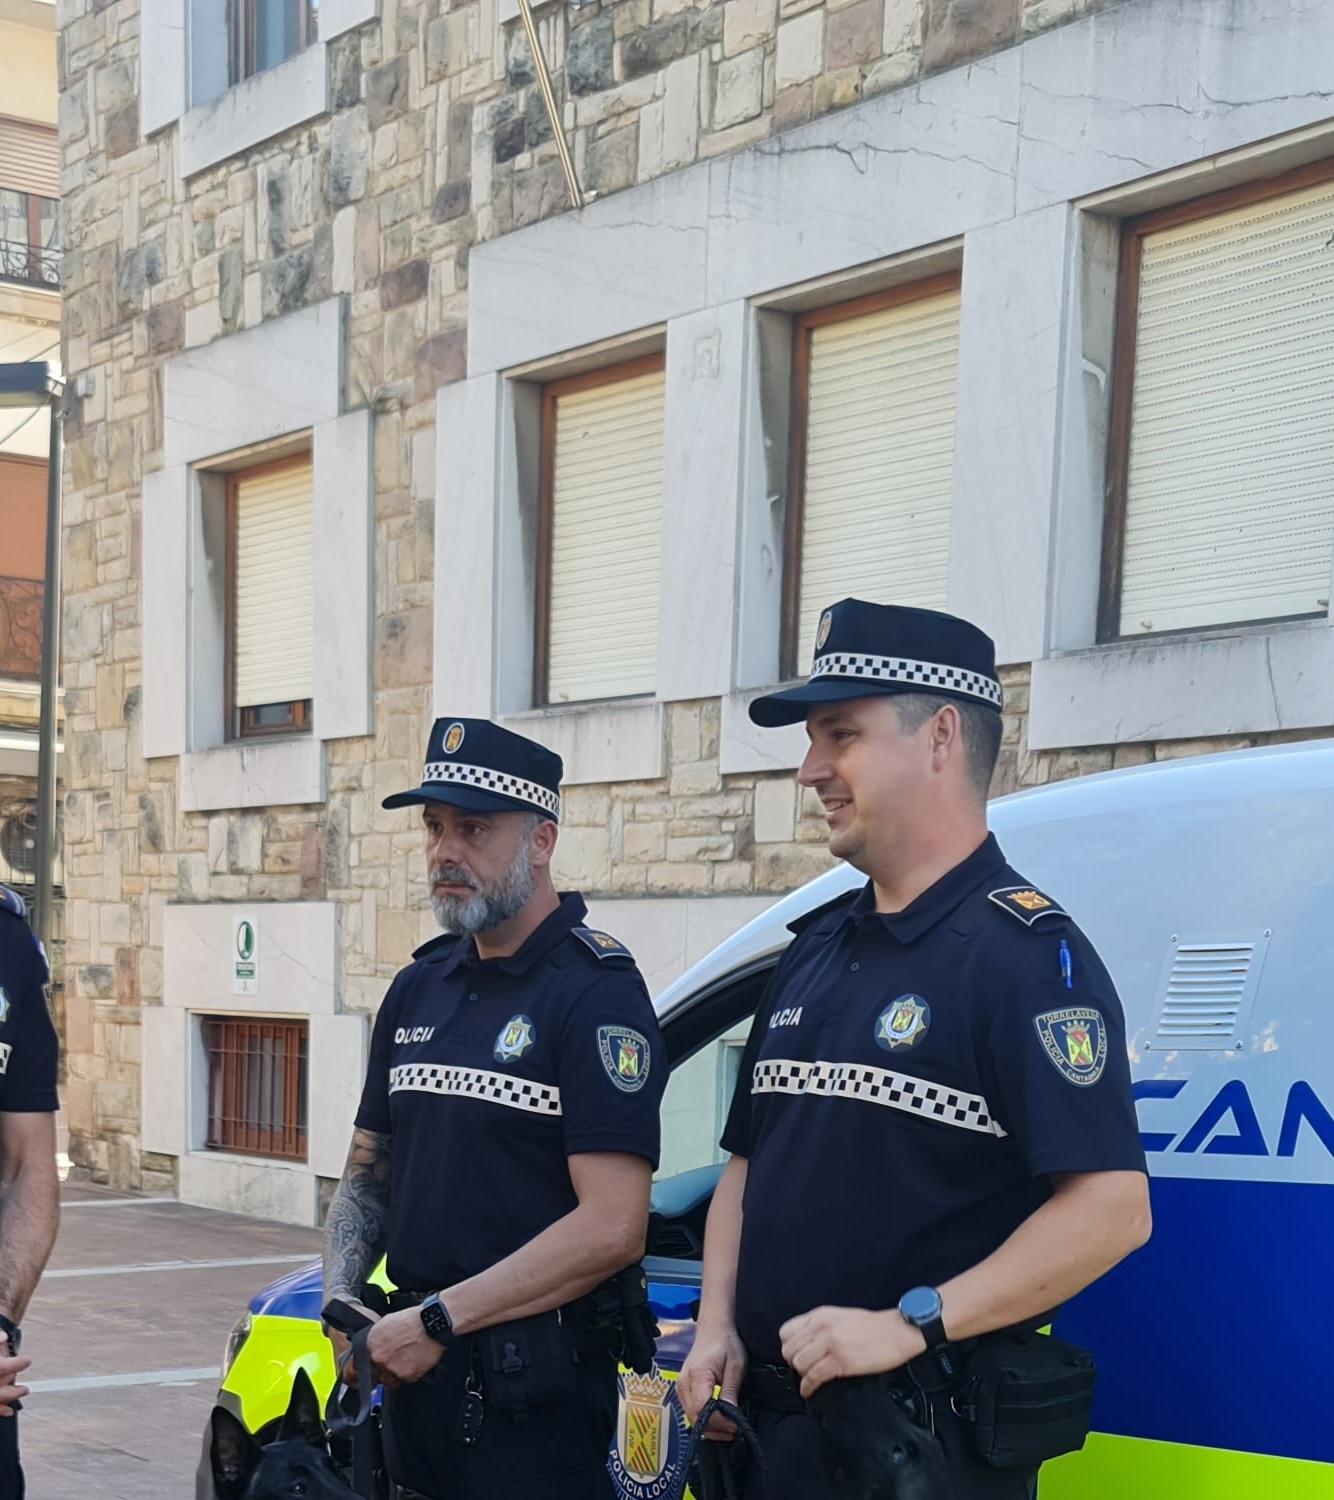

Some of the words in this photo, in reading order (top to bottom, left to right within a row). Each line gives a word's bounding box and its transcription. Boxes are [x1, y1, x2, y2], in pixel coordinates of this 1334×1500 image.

[394, 1026, 436, 1044] OLICIA
[1042, 1029, 1065, 1065] POLICIA
[609, 1448, 644, 1499] POLICIA
[647, 1462, 677, 1499] LOCAL
